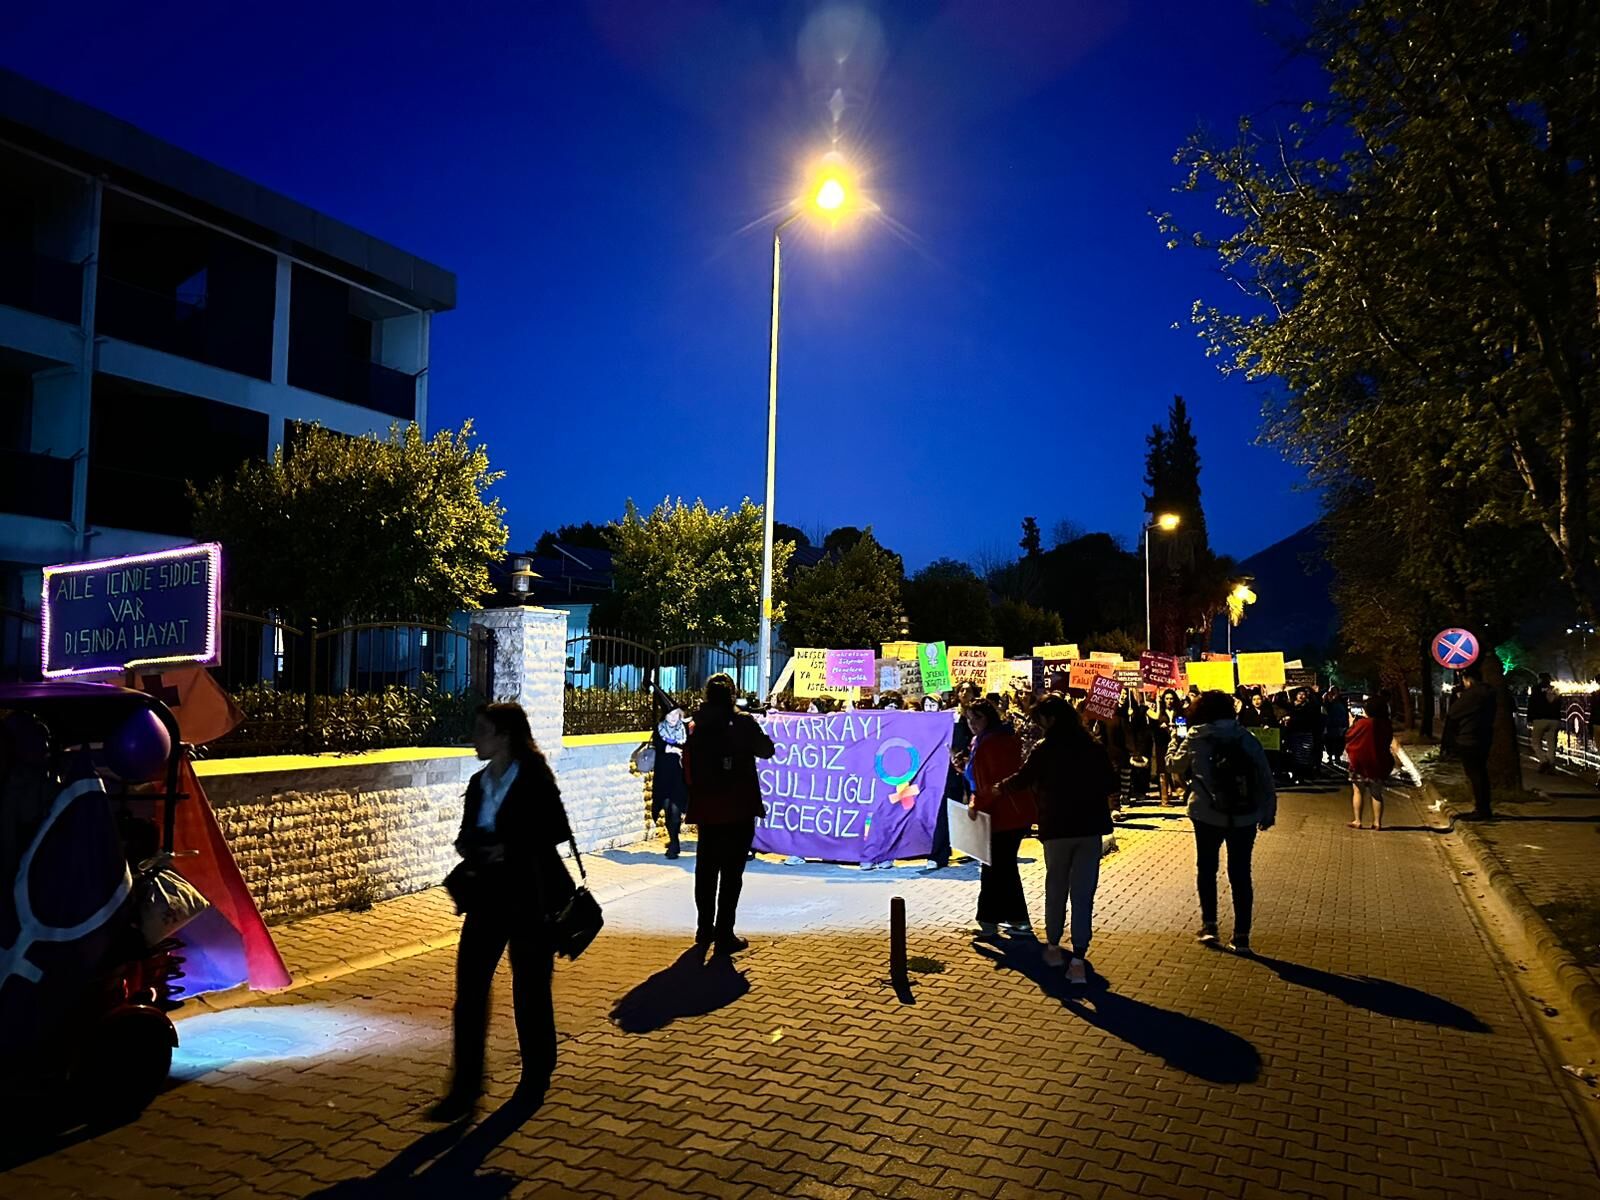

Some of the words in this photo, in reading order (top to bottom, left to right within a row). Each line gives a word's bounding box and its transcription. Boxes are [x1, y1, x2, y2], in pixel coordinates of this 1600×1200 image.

[108, 597, 145, 622] VAR
[133, 619, 189, 649] HAYAT
[756, 742, 846, 770] CAĞIZ
[758, 769, 876, 805] SULLUĞU
